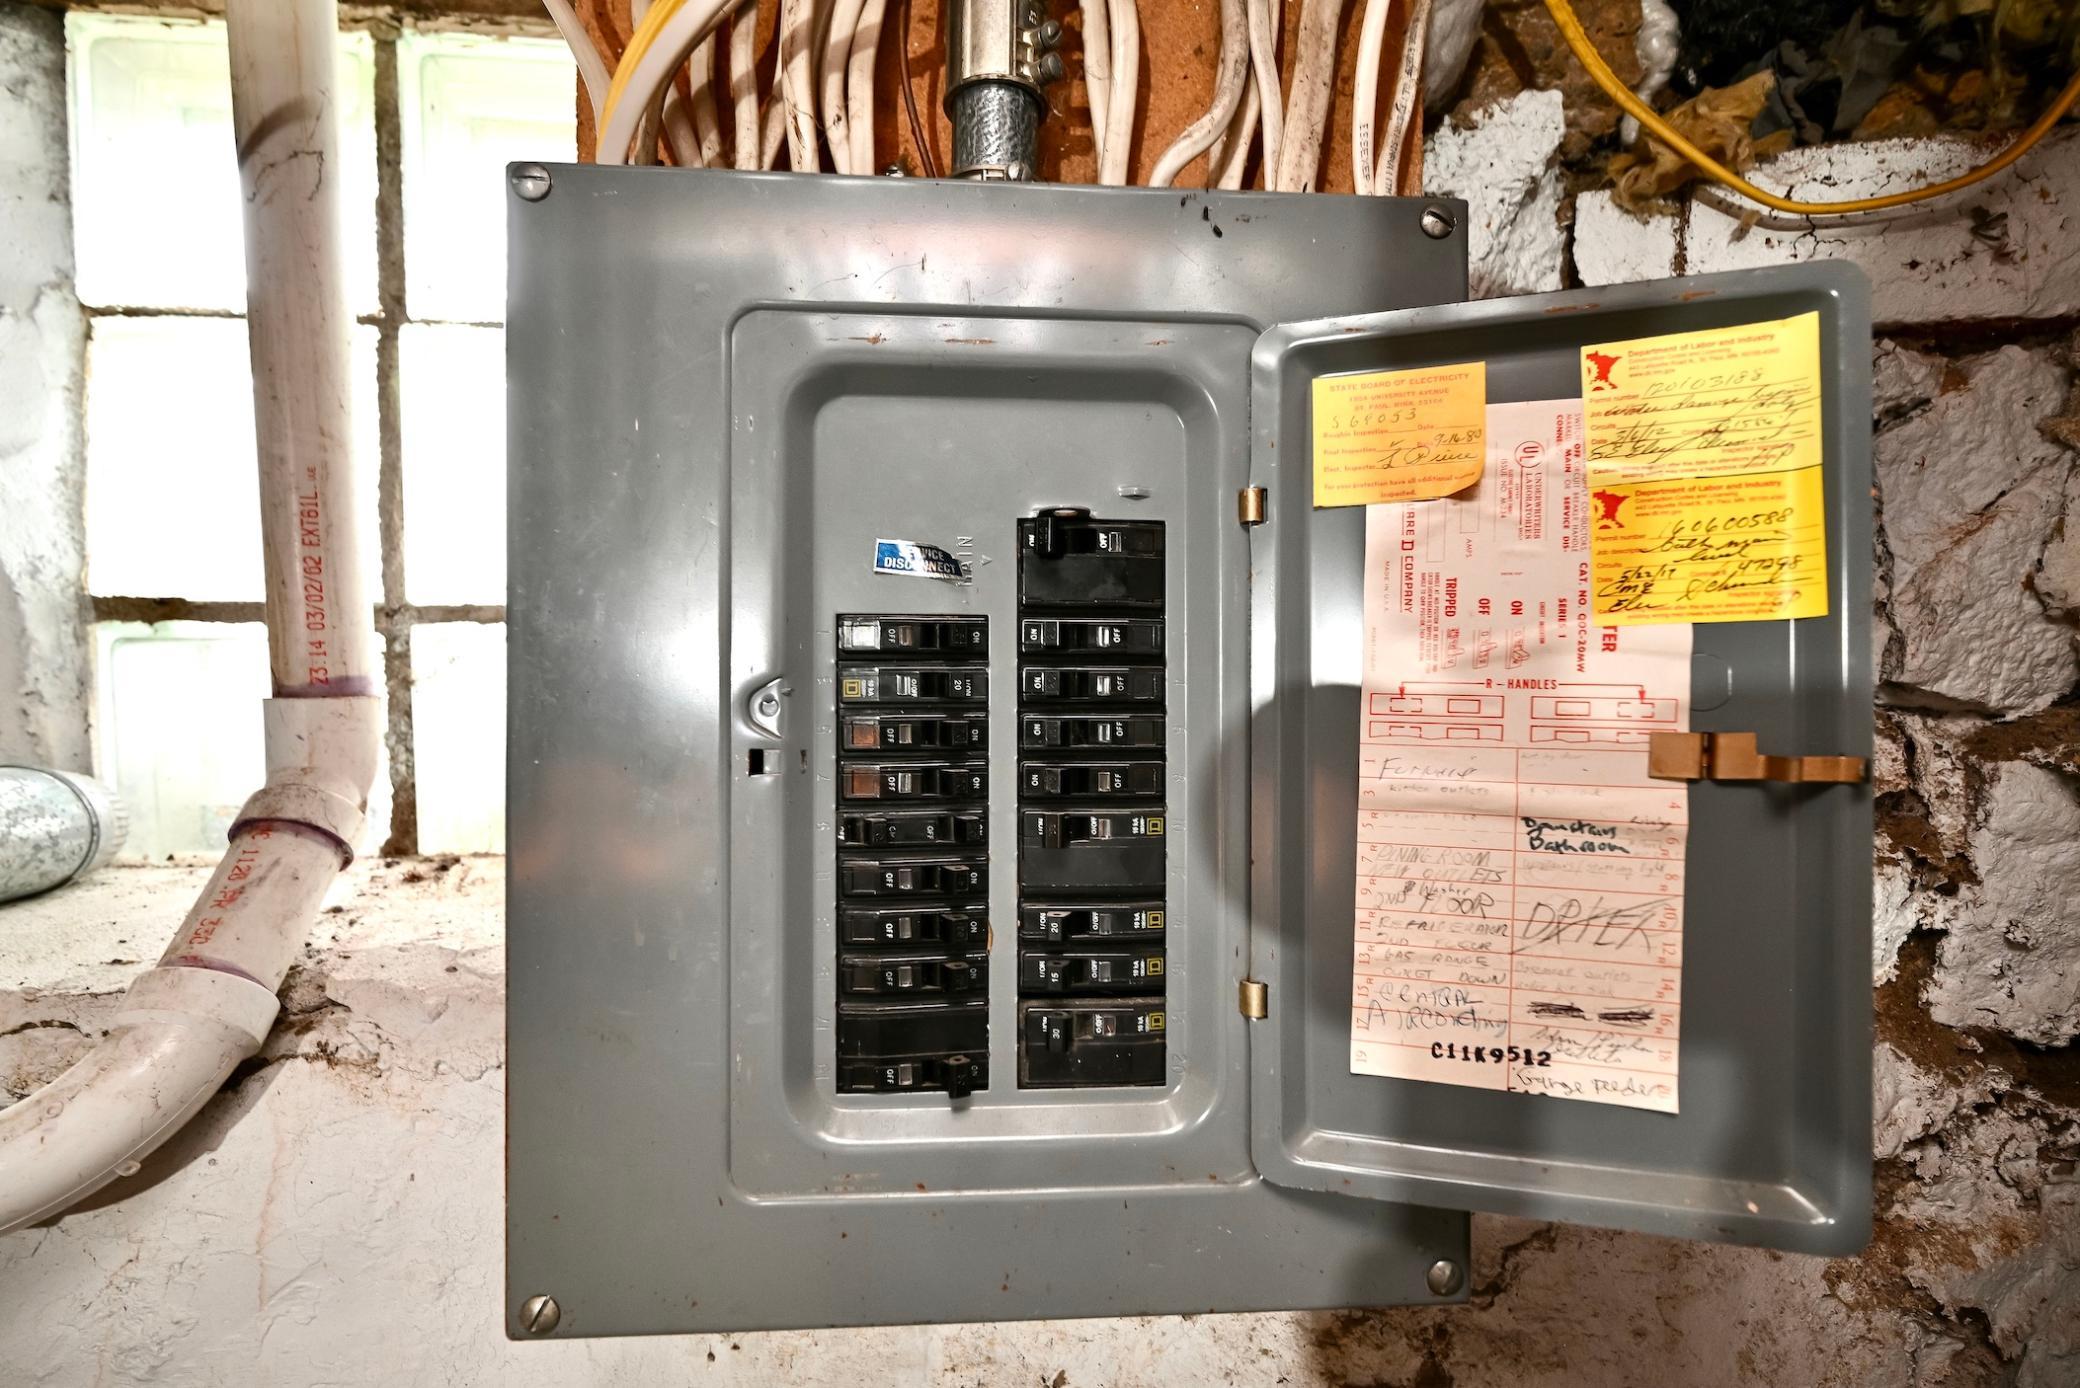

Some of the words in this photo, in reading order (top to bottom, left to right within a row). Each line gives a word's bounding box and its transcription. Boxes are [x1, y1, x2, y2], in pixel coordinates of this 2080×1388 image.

[1628, 345, 1677, 357] Department
[1681, 343, 1689, 351] of
[1691, 340, 1717, 350] Labor
[1719, 339, 1735, 347] and
[1738, 333, 1775, 346] Industry
[1330, 384, 1358, 392] STATE
[1361, 381, 1391, 390] BOARD
[1409, 374, 1470, 385] ELECTRICITY
[1371, 391, 1417, 401] UNIVERSITY
[1419, 388, 1449, 397] AVENUE
[1500, 458, 1508, 477] ISSUE
[1635, 486, 1685, 497] Department
[1688, 485, 1697, 493] of
[1698, 482, 1724, 492] Labor
[1726, 482, 1742, 490] and
[1744, 478, 1782, 490] Industry
[1525, 472, 1533, 540] LABORATORIES
[1534, 472, 1542, 540] UNDERWRITERS
[1572, 524, 1580, 553] HANDLE
[1578, 562, 1588, 586] CAT.
[1404, 556, 1414, 614] COMPANY
[1445, 578, 1457, 617] TRIPPED
[1578, 590, 1587, 609] NO.
[1478, 598, 1490, 616] OFF
[1511, 600, 1523, 616] ON
[888, 628, 896, 643] OFF
[1030, 628, 1038, 641] ON
[954, 680, 962, 691] 20
[1034, 676, 1042, 689] ON
[1117, 676, 1125, 691] OFF
[1486, 678, 1493, 689] R
[1508, 679, 1558, 690] HANDLES
[887, 728, 895, 743] OFF
[1034, 724, 1041, 736] ON
[1116, 722, 1124, 737] OFF
[888, 776, 896, 791] OFF
[1032, 774, 1039, 786] ON
[1114, 774, 1122, 788] OFF
[886, 872, 894, 888] OFF
[886, 923, 894, 939] OFF
[1052, 922, 1059, 933] 20
[1663, 942, 1677, 956] 12
[1359, 952, 1371, 965] 13
[1052, 972, 1059, 983] 15
[1662, 978, 1675, 993] 14
[1662, 1014, 1675, 1027] 16
